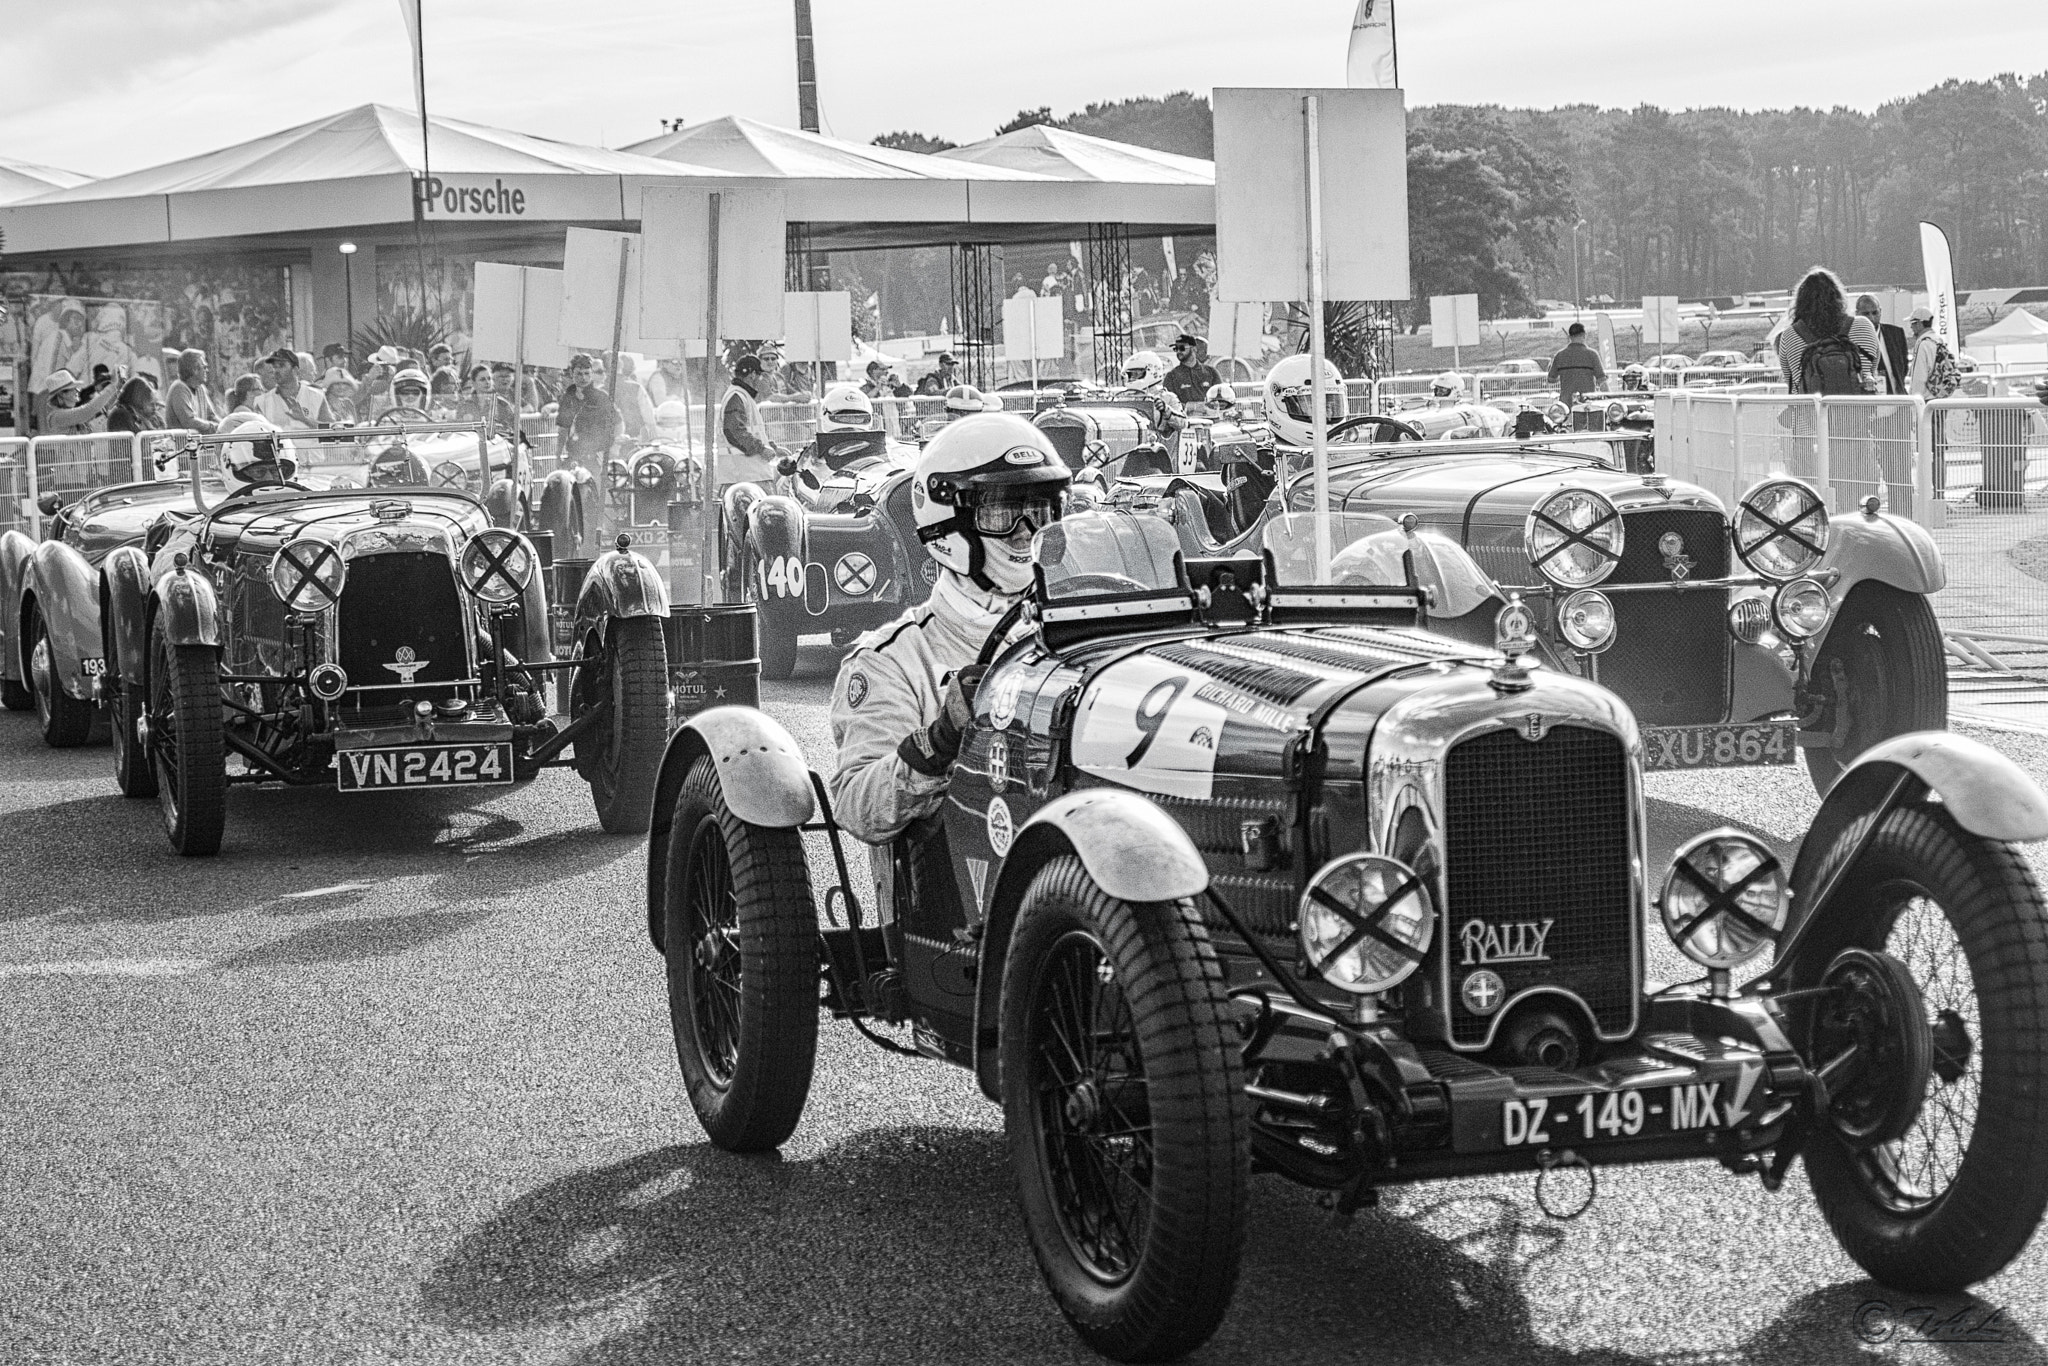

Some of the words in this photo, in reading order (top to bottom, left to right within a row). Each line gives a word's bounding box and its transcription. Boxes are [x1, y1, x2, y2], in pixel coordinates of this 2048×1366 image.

[427, 177, 525, 214] Porsche
[1013, 450, 1039, 459] BELL
[758, 555, 804, 600] 140
[82, 659, 106, 674] 193
[672, 684, 707, 694] MOTUL
[1125, 675, 1190, 770] 9
[1197, 683, 1256, 714] RICHARD
[1252, 704, 1295, 733] MILLE
[1714, 729, 1787, 763] 864
[1460, 919, 1555, 965] RALLY
